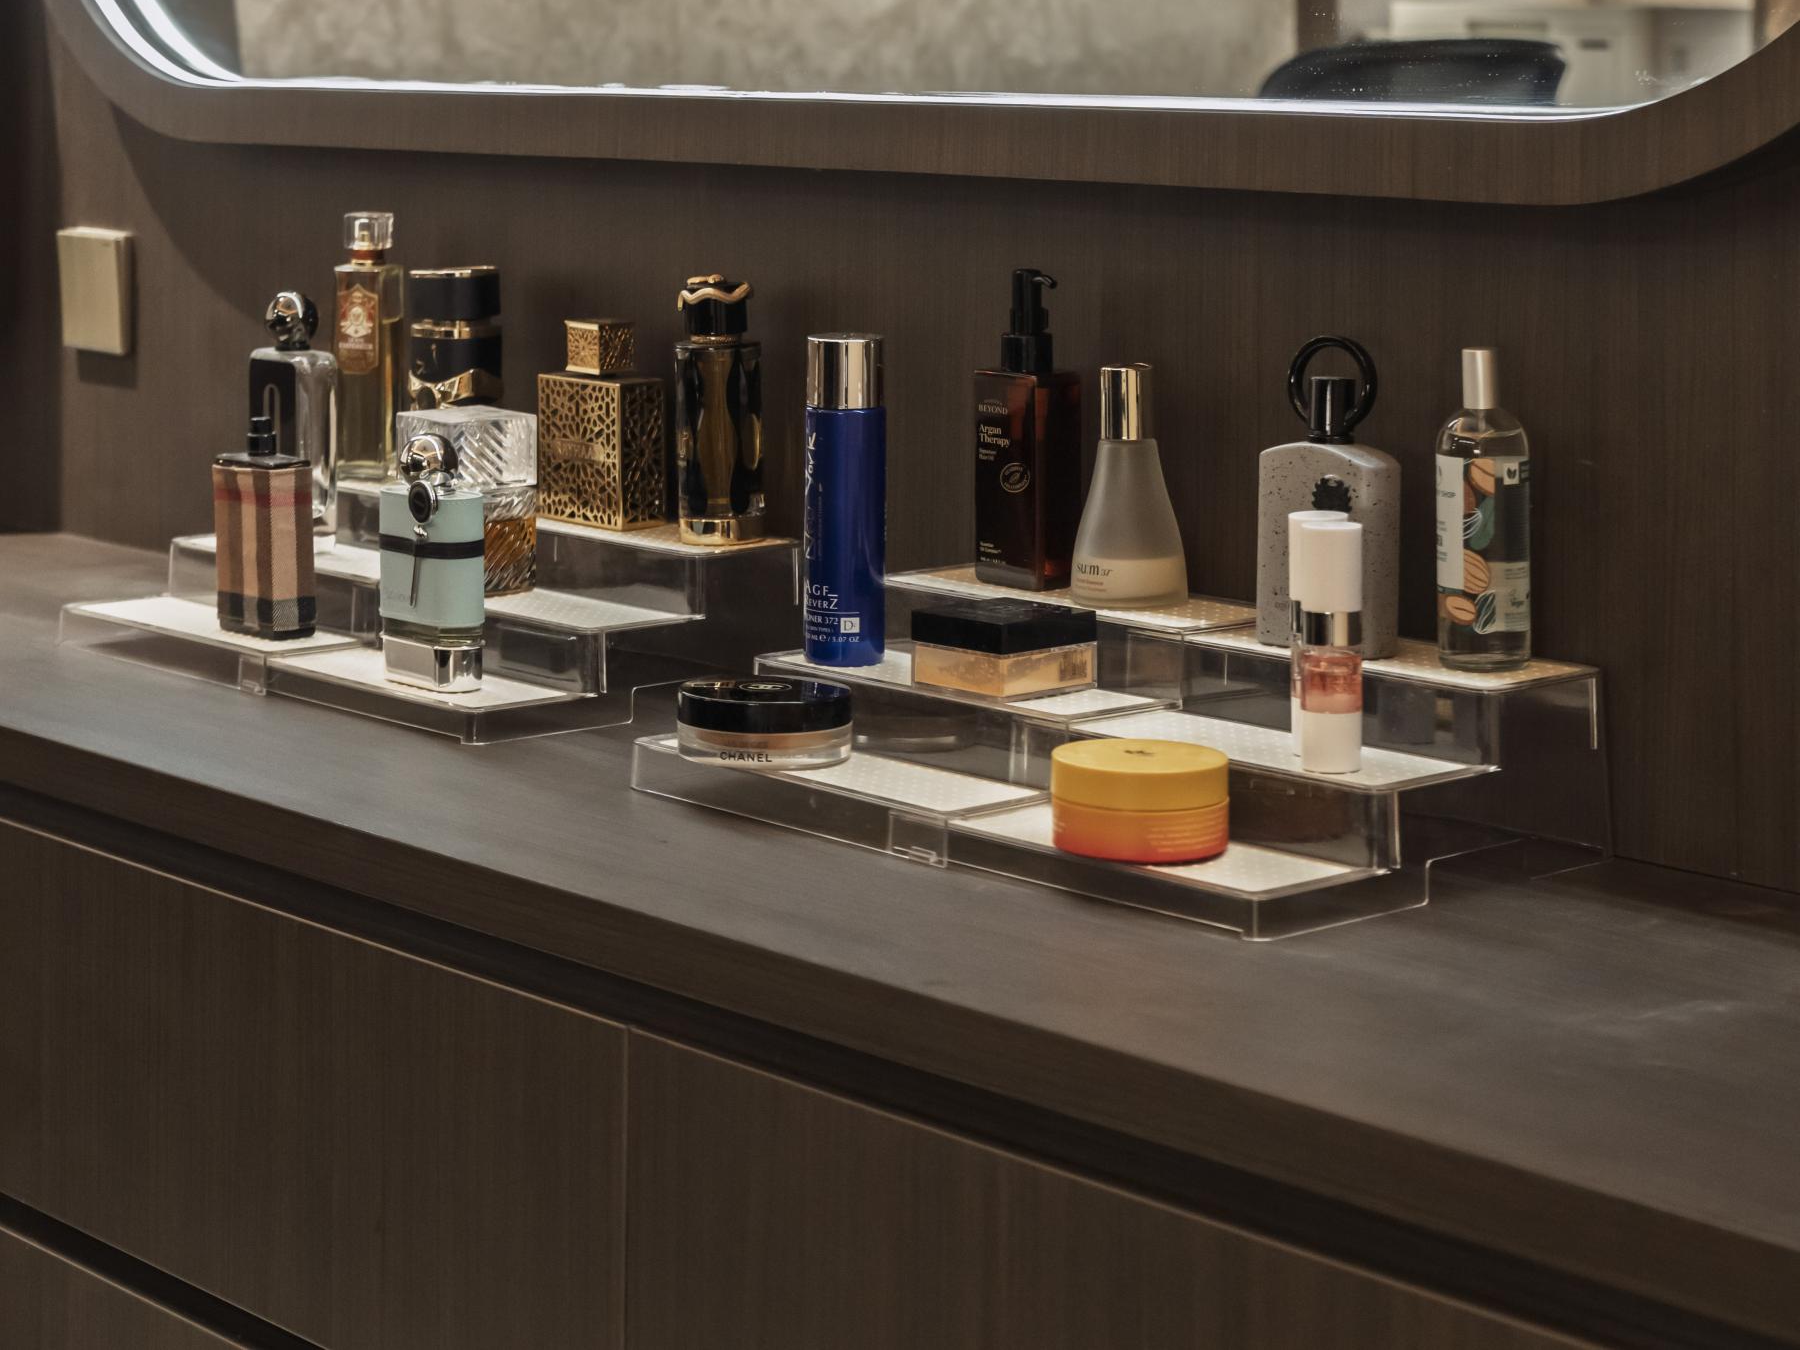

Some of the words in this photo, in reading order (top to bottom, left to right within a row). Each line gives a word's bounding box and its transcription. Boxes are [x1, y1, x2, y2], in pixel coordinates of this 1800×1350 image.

[978, 404, 1008, 415] BEYOND
[979, 424, 1002, 435] Argan
[979, 433, 1010, 448] Therapy
[720, 752, 772, 762] CHANEL
